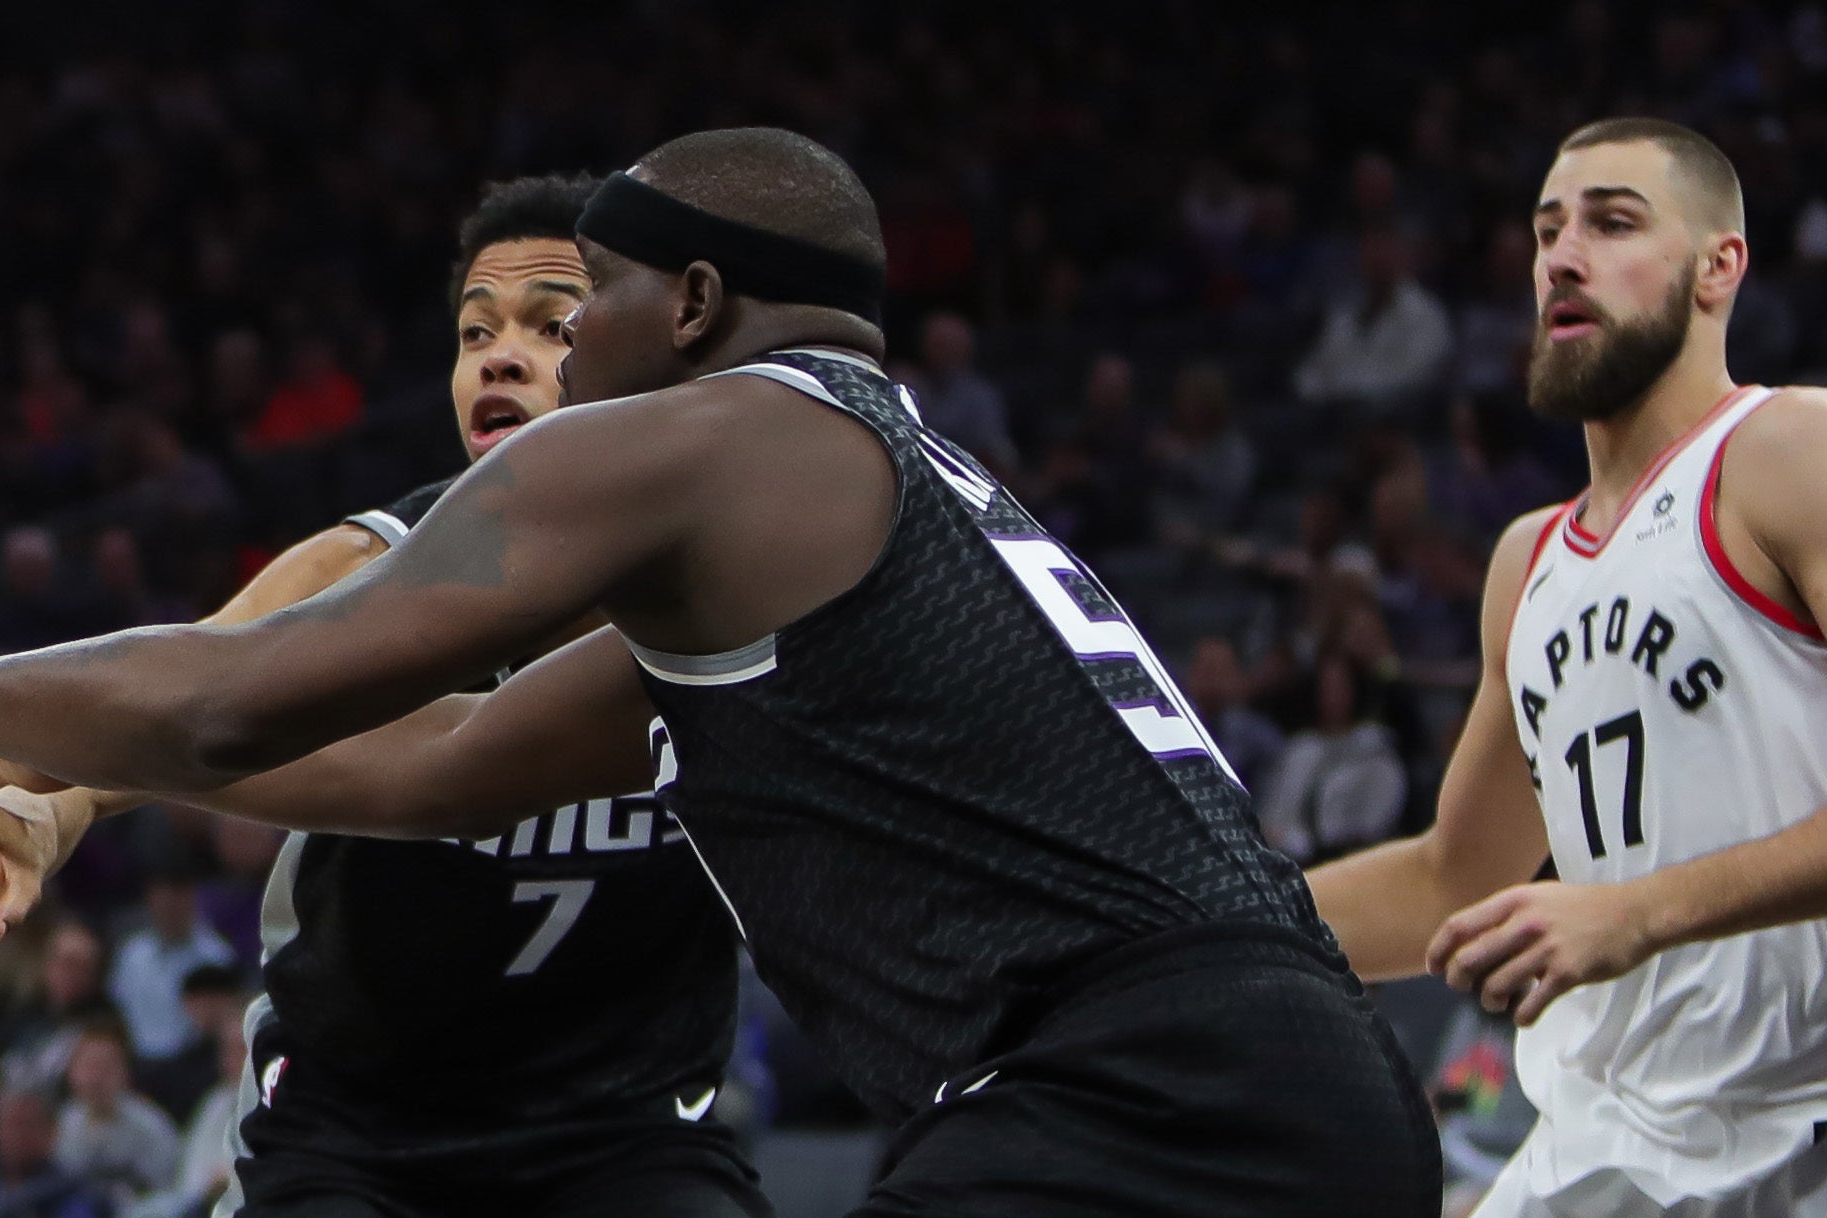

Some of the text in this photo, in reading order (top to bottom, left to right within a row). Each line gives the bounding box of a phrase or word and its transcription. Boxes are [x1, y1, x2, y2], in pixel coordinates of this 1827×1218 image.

[1520, 594, 1725, 794] APTORS
[1564, 708, 1646, 861] 17
[504, 879, 596, 977] 7
